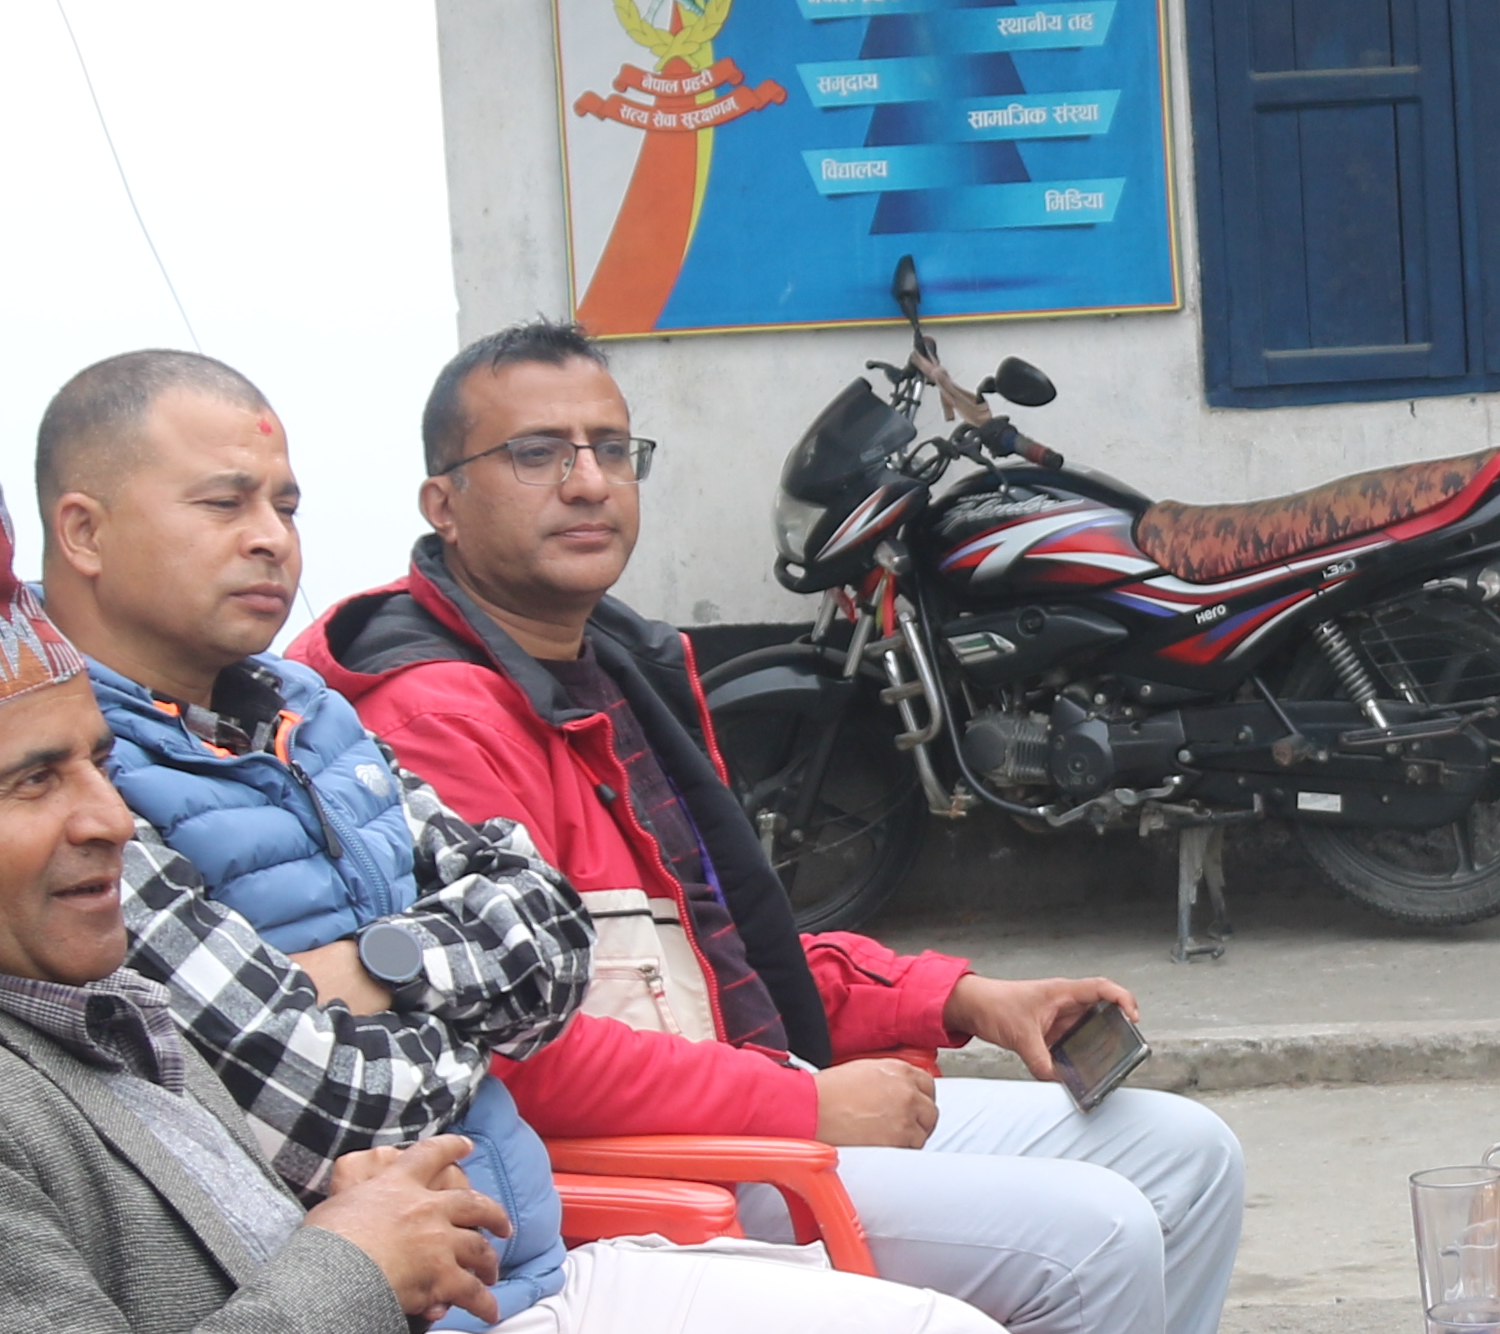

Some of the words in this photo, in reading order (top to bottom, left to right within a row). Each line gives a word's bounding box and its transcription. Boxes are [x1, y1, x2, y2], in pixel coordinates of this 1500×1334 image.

[997, 11, 1062, 35] स्थानीय
[1068, 12, 1094, 31] तह
[641, 75, 678, 93] नेपाल
[682, 69, 714, 93] प्रहरी
[816, 73, 879, 95] समुदाय
[619, 103, 649, 124] सत्य
[653, 111, 677, 128] सेवा
[968, 103, 1047, 129] सामाजिक
[1053, 103, 1099, 124] संस्था
[821, 158, 887, 181] विद्यालय
[1045, 188, 1104, 212] मिडिया
